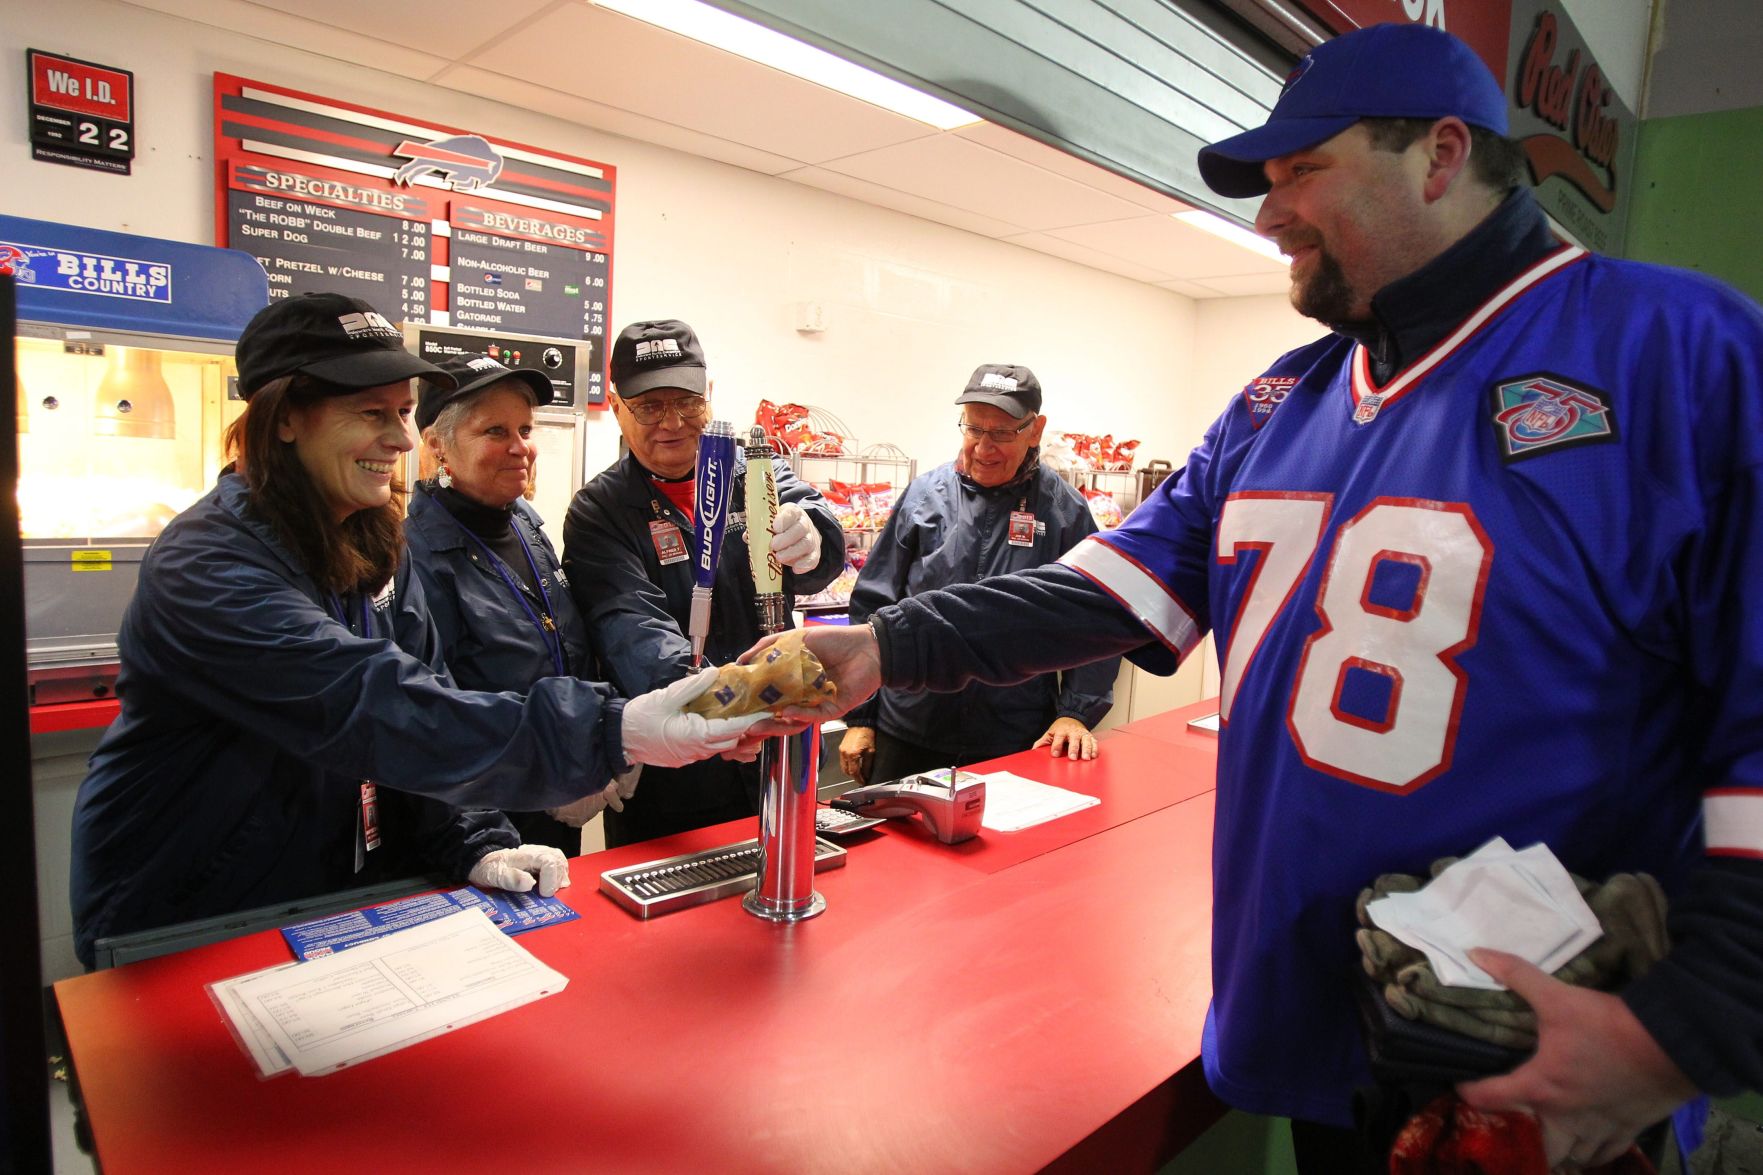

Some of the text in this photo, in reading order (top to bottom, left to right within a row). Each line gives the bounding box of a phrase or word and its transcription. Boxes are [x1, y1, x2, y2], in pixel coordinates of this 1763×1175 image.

[47, 69, 116, 105] We I.D.
[36, 114, 71, 126] DECEMBER
[36, 149, 92, 163] RESPONSIBILITY
[94, 158, 126, 170] MATTERS
[265, 172, 405, 210] SPECIALTIES
[255, 196, 336, 219] BEEF ON WECK
[241, 224, 308, 243] SUPER DOG
[313, 221, 354, 236] DOUBLE
[356, 227, 382, 240] BEEF
[483, 213, 586, 243] BEVERAGES
[458, 230, 547, 253] LARGE DRAFT BEER
[57, 253, 167, 286] BILLS
[276, 258, 324, 273] PRETZEL
[457, 256, 550, 279] NON-ALCOHOLIC BEER
[68, 276, 156, 297] COUNTRY
[268, 273, 292, 284] ORN
[269, 288, 289, 298] UTS
[457, 283, 520, 300] BOTTLED SODA
[457, 296, 526, 313] BOTTLED WATER
[457, 310, 502, 323] GATORADE
[589, 373, 601, 383] .00
[1259, 377, 1296, 385] BILLS
[589, 386, 600, 395] .00
[1250, 384, 1292, 403] 35
[1525, 410, 1556, 431] NFL
[701, 457, 718, 571] BUD LIGHT
[1217, 490, 1494, 796] 78
